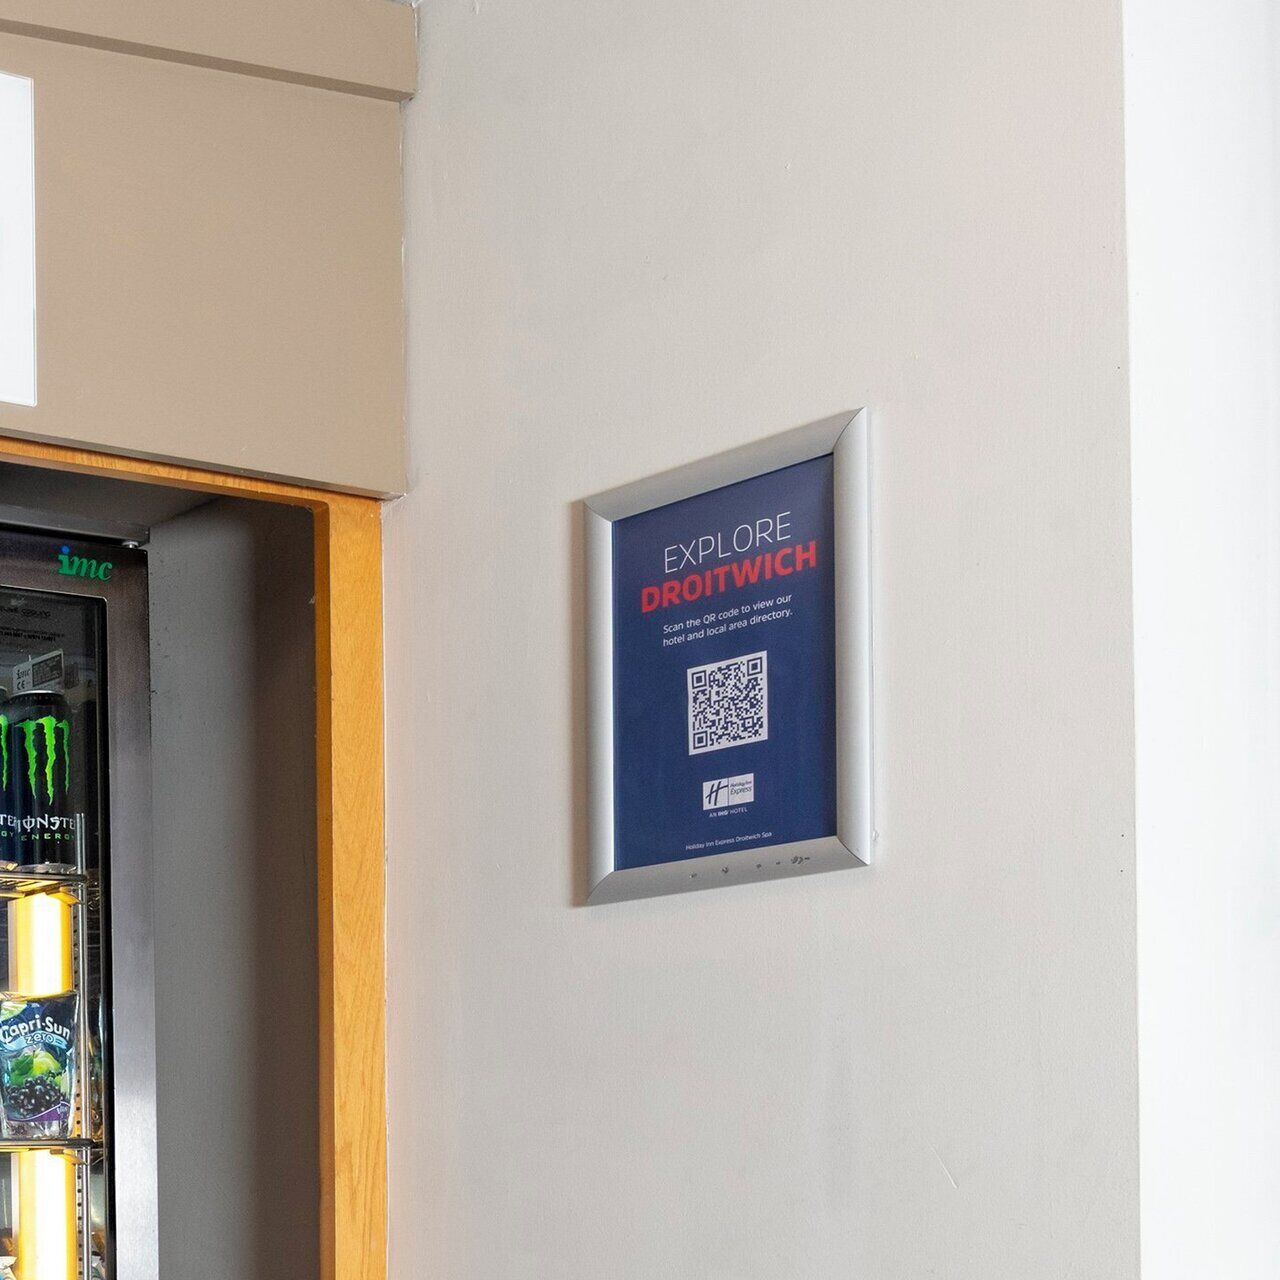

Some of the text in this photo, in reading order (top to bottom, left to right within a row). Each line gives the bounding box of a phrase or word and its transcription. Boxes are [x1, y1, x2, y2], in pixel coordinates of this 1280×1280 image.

[664, 511, 791, 573] EXPLORE
[58, 545, 113, 580] imc
[641, 540, 817, 613] DROITWICH
[663, 594, 792, 634] Scan the QR code to view our
[663, 608, 793, 647] hotel and local area directory.
[730, 786, 752, 795] Express
[715, 839, 734, 847] Express
[736, 834, 761, 843] Droitwich
[761, 831, 773, 839] Spa
[26, 1033, 54, 1044] zero
